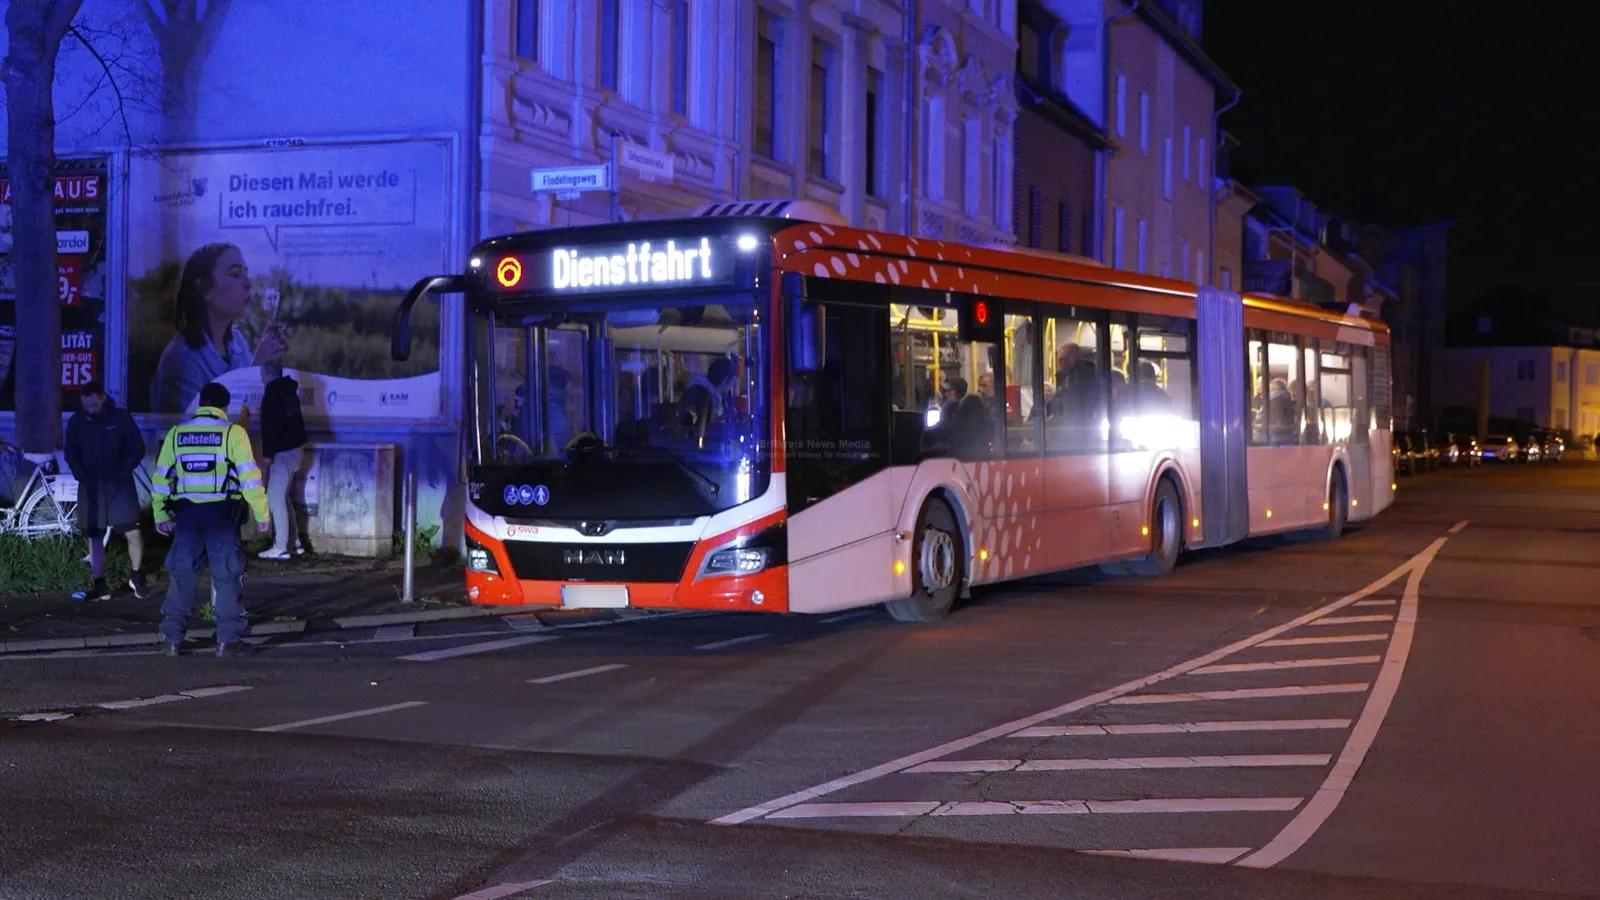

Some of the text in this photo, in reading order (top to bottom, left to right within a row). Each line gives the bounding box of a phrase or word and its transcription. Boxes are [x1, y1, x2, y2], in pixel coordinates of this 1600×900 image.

[229, 169, 399, 192] Diesen Mai werde
[228, 198, 357, 218] ich rauchfrei.
[553, 237, 712, 289] Dienstfahrt
[178, 433, 221, 446] Leitstelle
[564, 550, 625, 564] MAN
